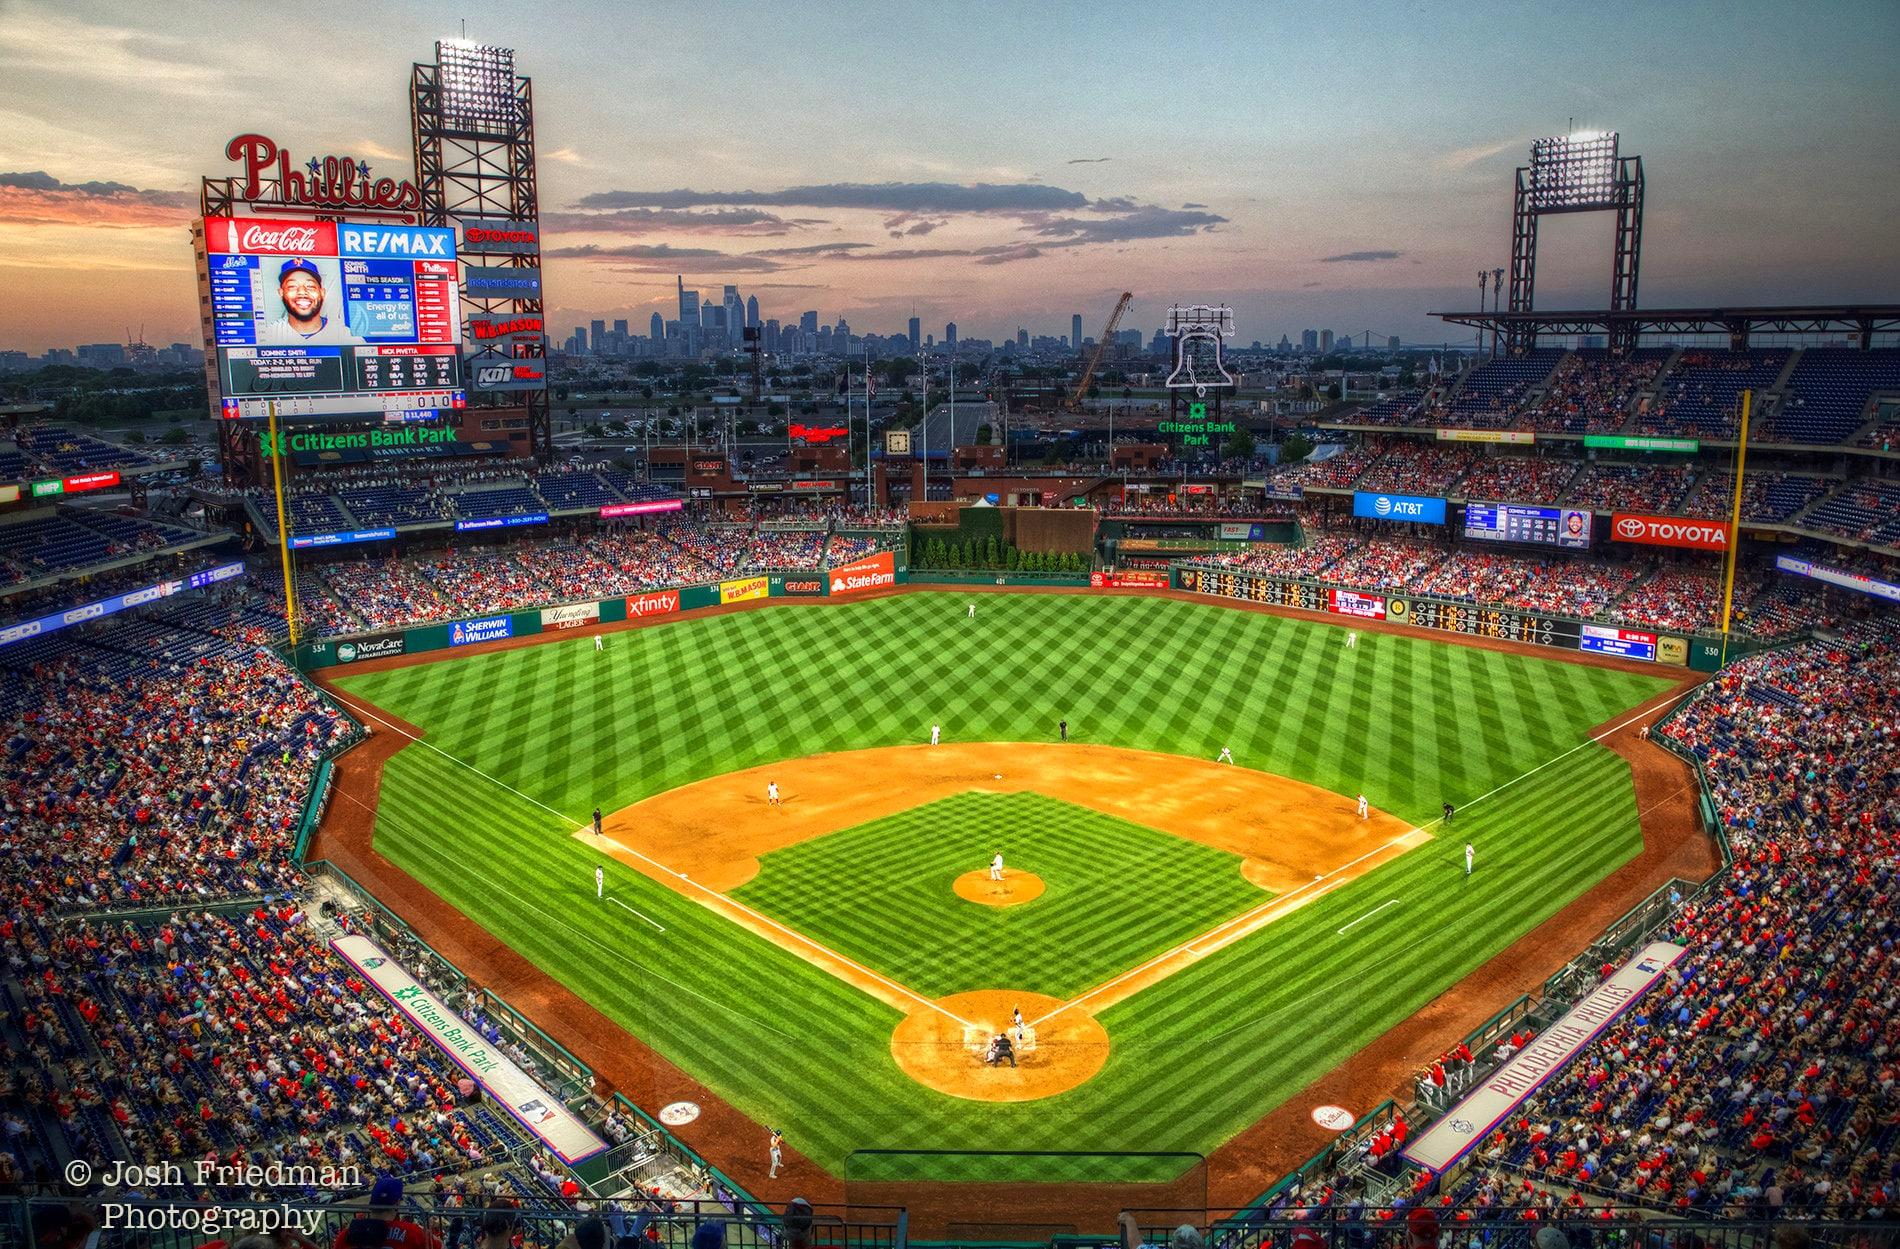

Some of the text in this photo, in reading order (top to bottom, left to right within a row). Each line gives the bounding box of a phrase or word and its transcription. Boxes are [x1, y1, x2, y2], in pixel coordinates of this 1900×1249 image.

[225, 133, 423, 211] Phillies
[243, 225, 320, 252] Coca-Cola
[344, 231, 445, 255] RE/MAX
[482, 229, 536, 243] TOYOTA
[344, 265, 369, 273] SMITH
[366, 302, 409, 312] Energy for
[376, 312, 386, 320] all
[478, 368, 513, 383] KDI
[418, 396, 425, 407] 0
[431, 396, 437, 407] 1
[442, 396, 449, 406] 0
[1158, 421, 1236, 434] Citizens Bank
[290, 426, 458, 451] Citizens Bank Park
[1183, 435, 1209, 446] Park
[693, 461, 723, 470] GIANT
[1393, 501, 1423, 515] AT&T
[1648, 522, 1726, 544] TOYOTA
[785, 581, 821, 592] GIANT
[629, 594, 677, 616] xfinity
[549, 605, 593, 621] Yuengling
[465, 618, 506, 633] SHERWIN
[558, 619, 585, 630] LAGER
[357, 638, 403, 653] NovaCare
[1663, 642, 1682, 653] WM
[1704, 647, 1719, 656] 330
[357, 648, 403, 660] REHABILITATION
[409, 996, 499, 1073] Citizens Bank Park
[1488, 983, 1633, 1099] PHILADELPHIA PHILLIES
